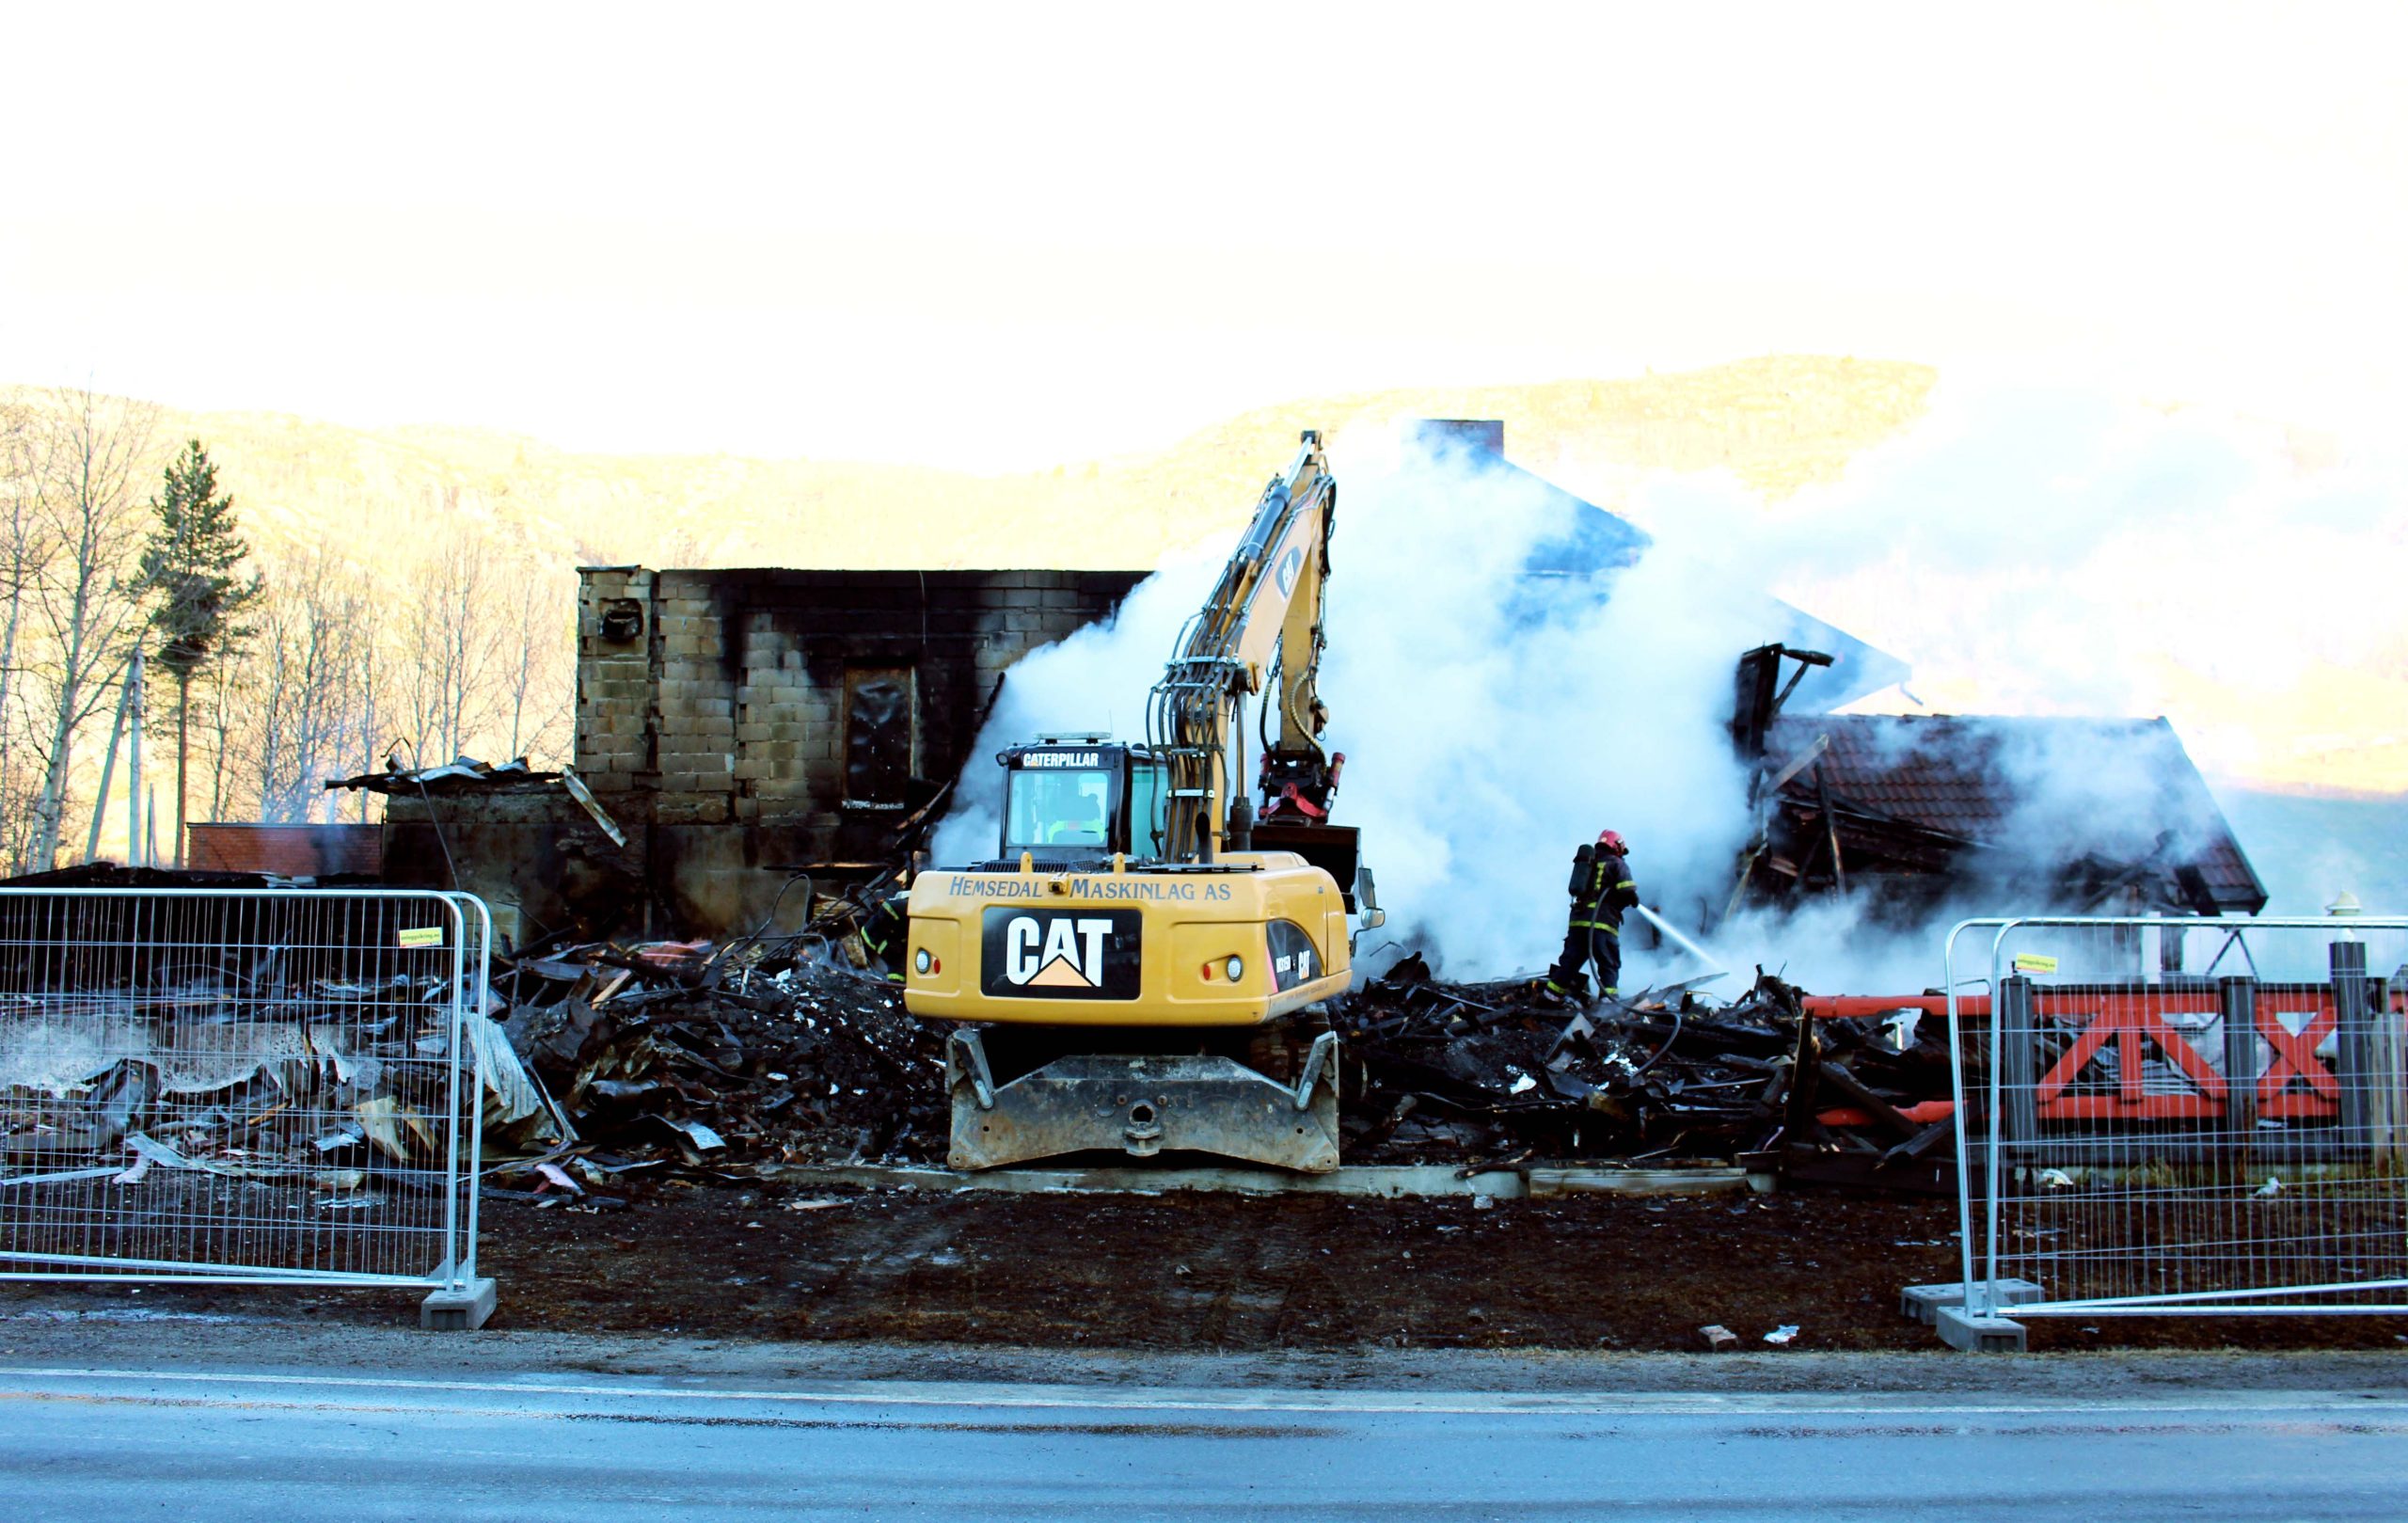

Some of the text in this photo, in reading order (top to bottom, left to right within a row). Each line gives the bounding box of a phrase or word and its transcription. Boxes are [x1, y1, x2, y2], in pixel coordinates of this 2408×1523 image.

[1282, 552, 1294, 594] CAT
[1022, 753, 1099, 767] CATERPILLAR
[949, 876, 1231, 900] HEMSEDAL MASKINLAG AS
[1006, 916, 1113, 987] CAT
[1298, 950, 1310, 980] CAT
